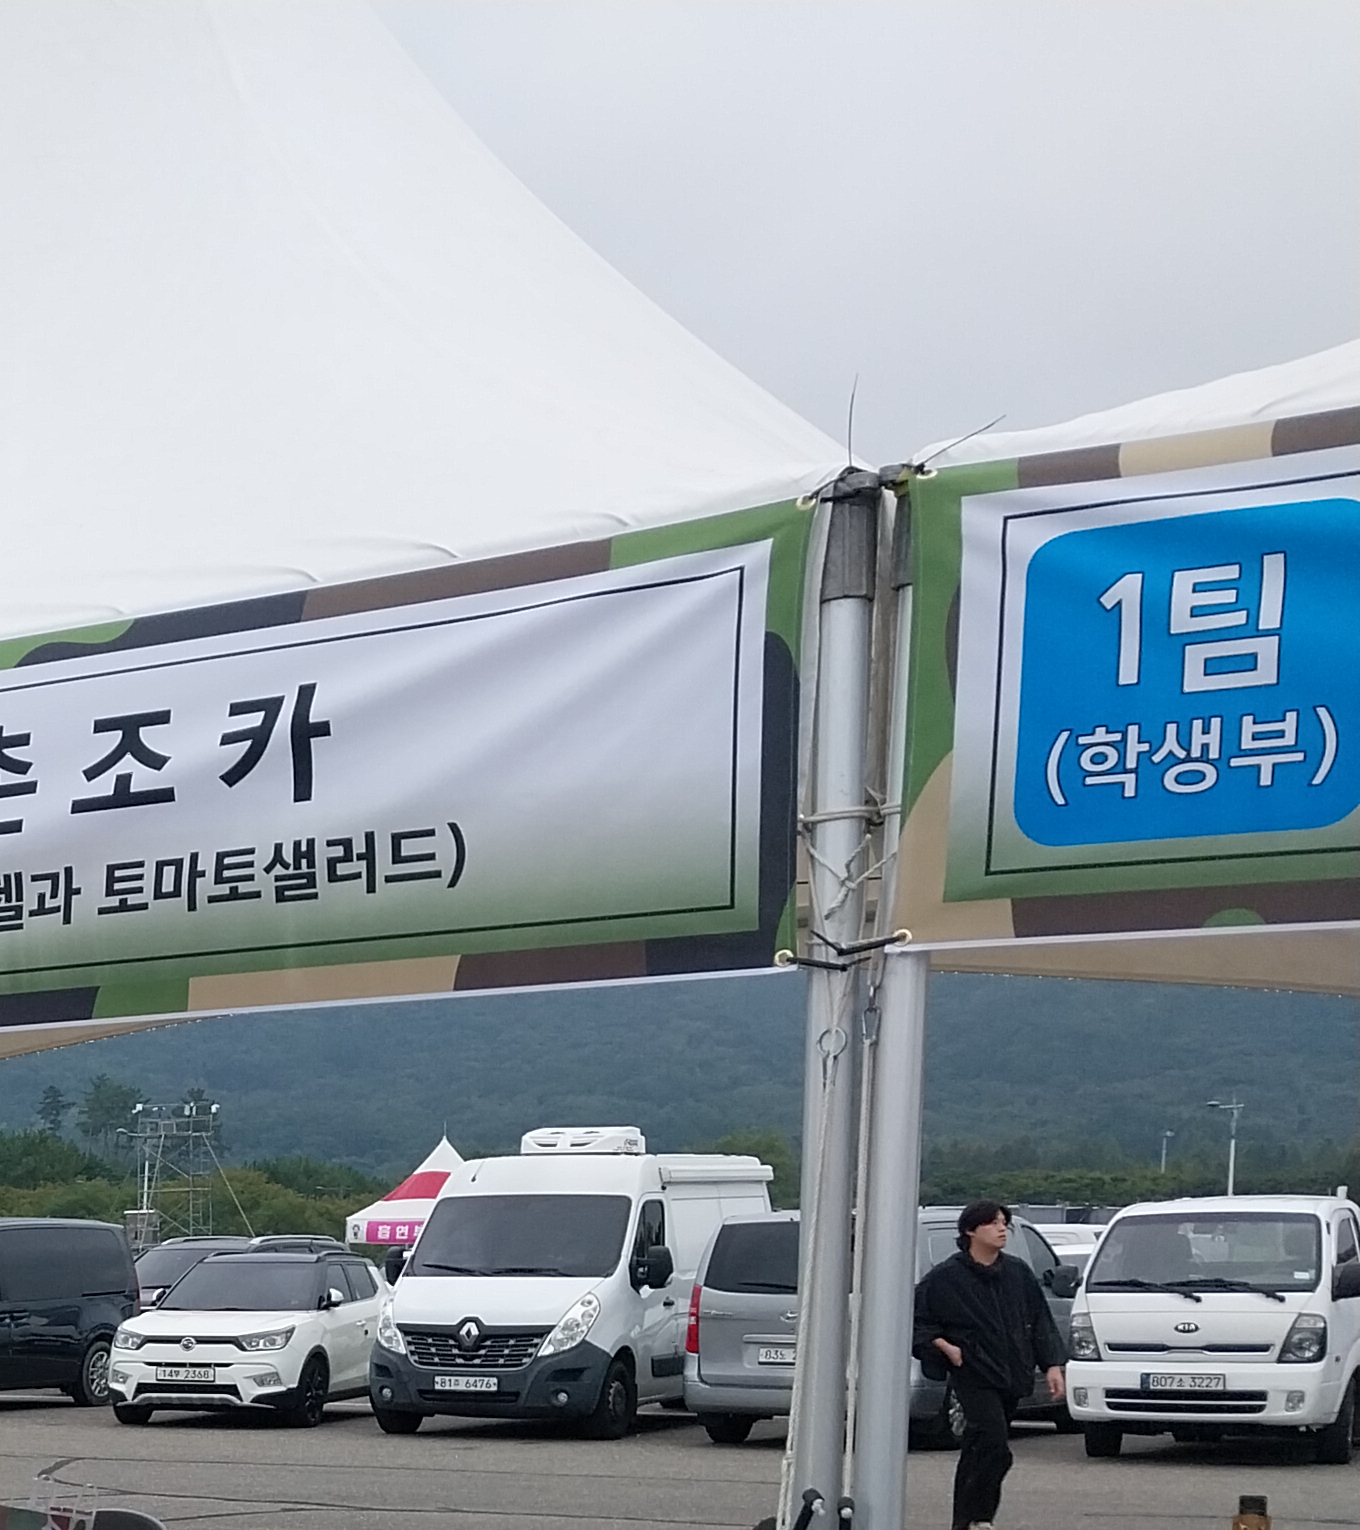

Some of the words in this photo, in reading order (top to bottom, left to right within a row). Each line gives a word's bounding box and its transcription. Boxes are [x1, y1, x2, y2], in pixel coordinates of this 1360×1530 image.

[1098, 551, 1287, 694] 1팀
[1046, 705, 1339, 807] (학생부)
[96, 821, 468, 917] 토마토샐러드)
[464, 1378, 492, 1389] 6476
[1189, 1376, 1222, 1388] 3227
